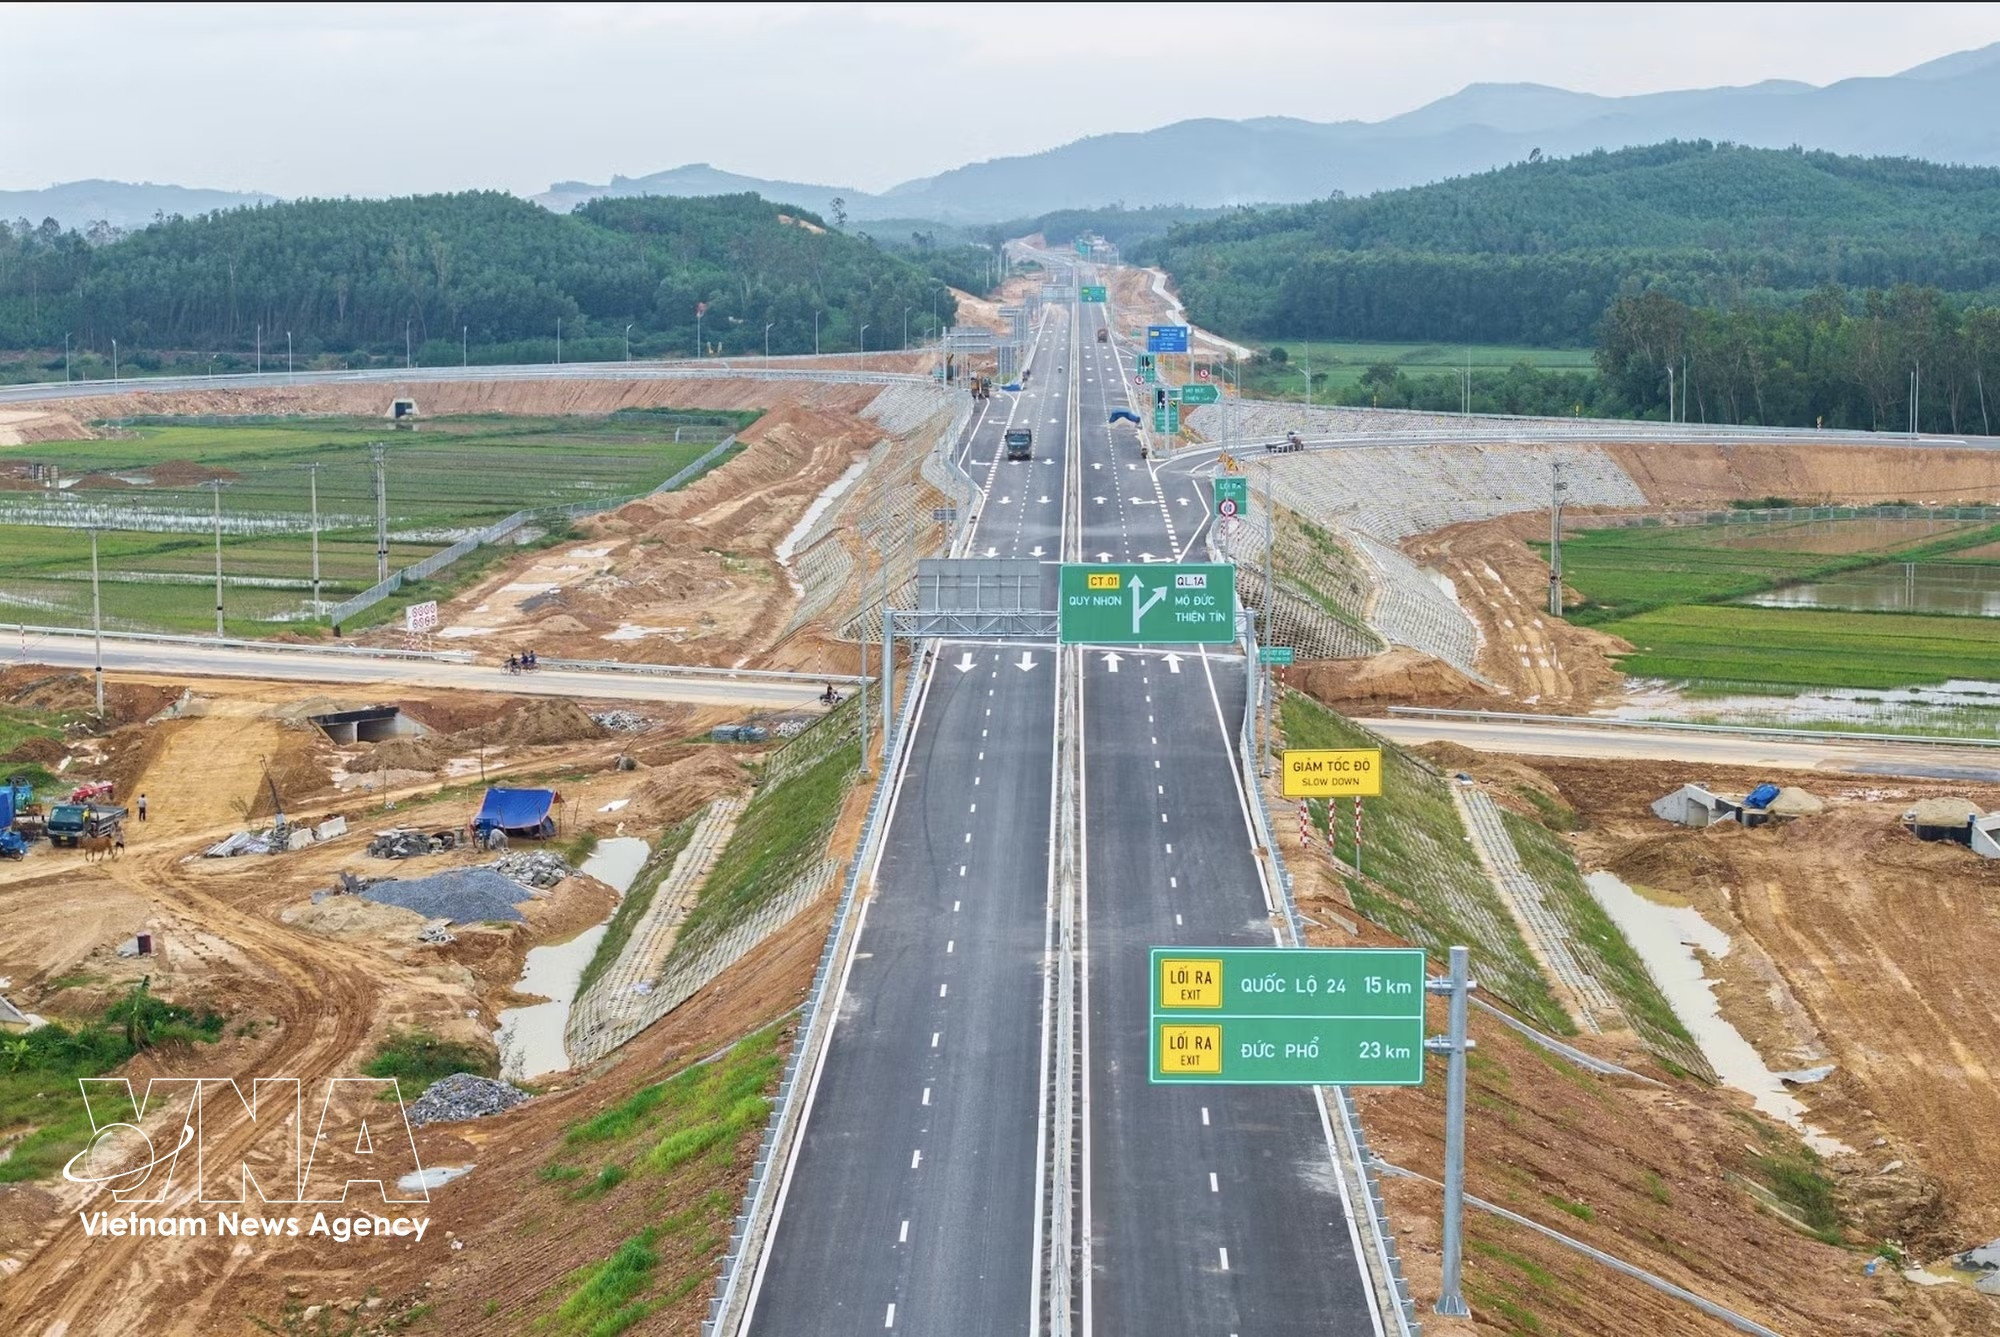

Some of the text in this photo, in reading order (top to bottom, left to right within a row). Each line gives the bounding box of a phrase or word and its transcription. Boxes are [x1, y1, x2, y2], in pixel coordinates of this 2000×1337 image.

[1090, 576, 1118, 586] CT.01
[1177, 576, 1204, 586] QL.1A
[1069, 596, 1090, 606] QUY
[1194, 594, 1214, 606] ĐỨC
[1175, 610, 1204, 624] THIỆN
[1293, 756, 1370, 773] GIẢM TỐC ĐỘ
[1332, 778, 1359, 786] DOWN
[1170, 966, 1212, 984] LỐI RA
[1240, 972, 1411, 996] QUỐC LỘ 24 15 km
[1180, 990, 1200, 1000] EXIT
[1170, 1031, 1212, 1050] LỐI RA
[1240, 1036, 1410, 1058] ĐỨC PHỔ 23 km
[1180, 1055, 1200, 1066] EXIT
